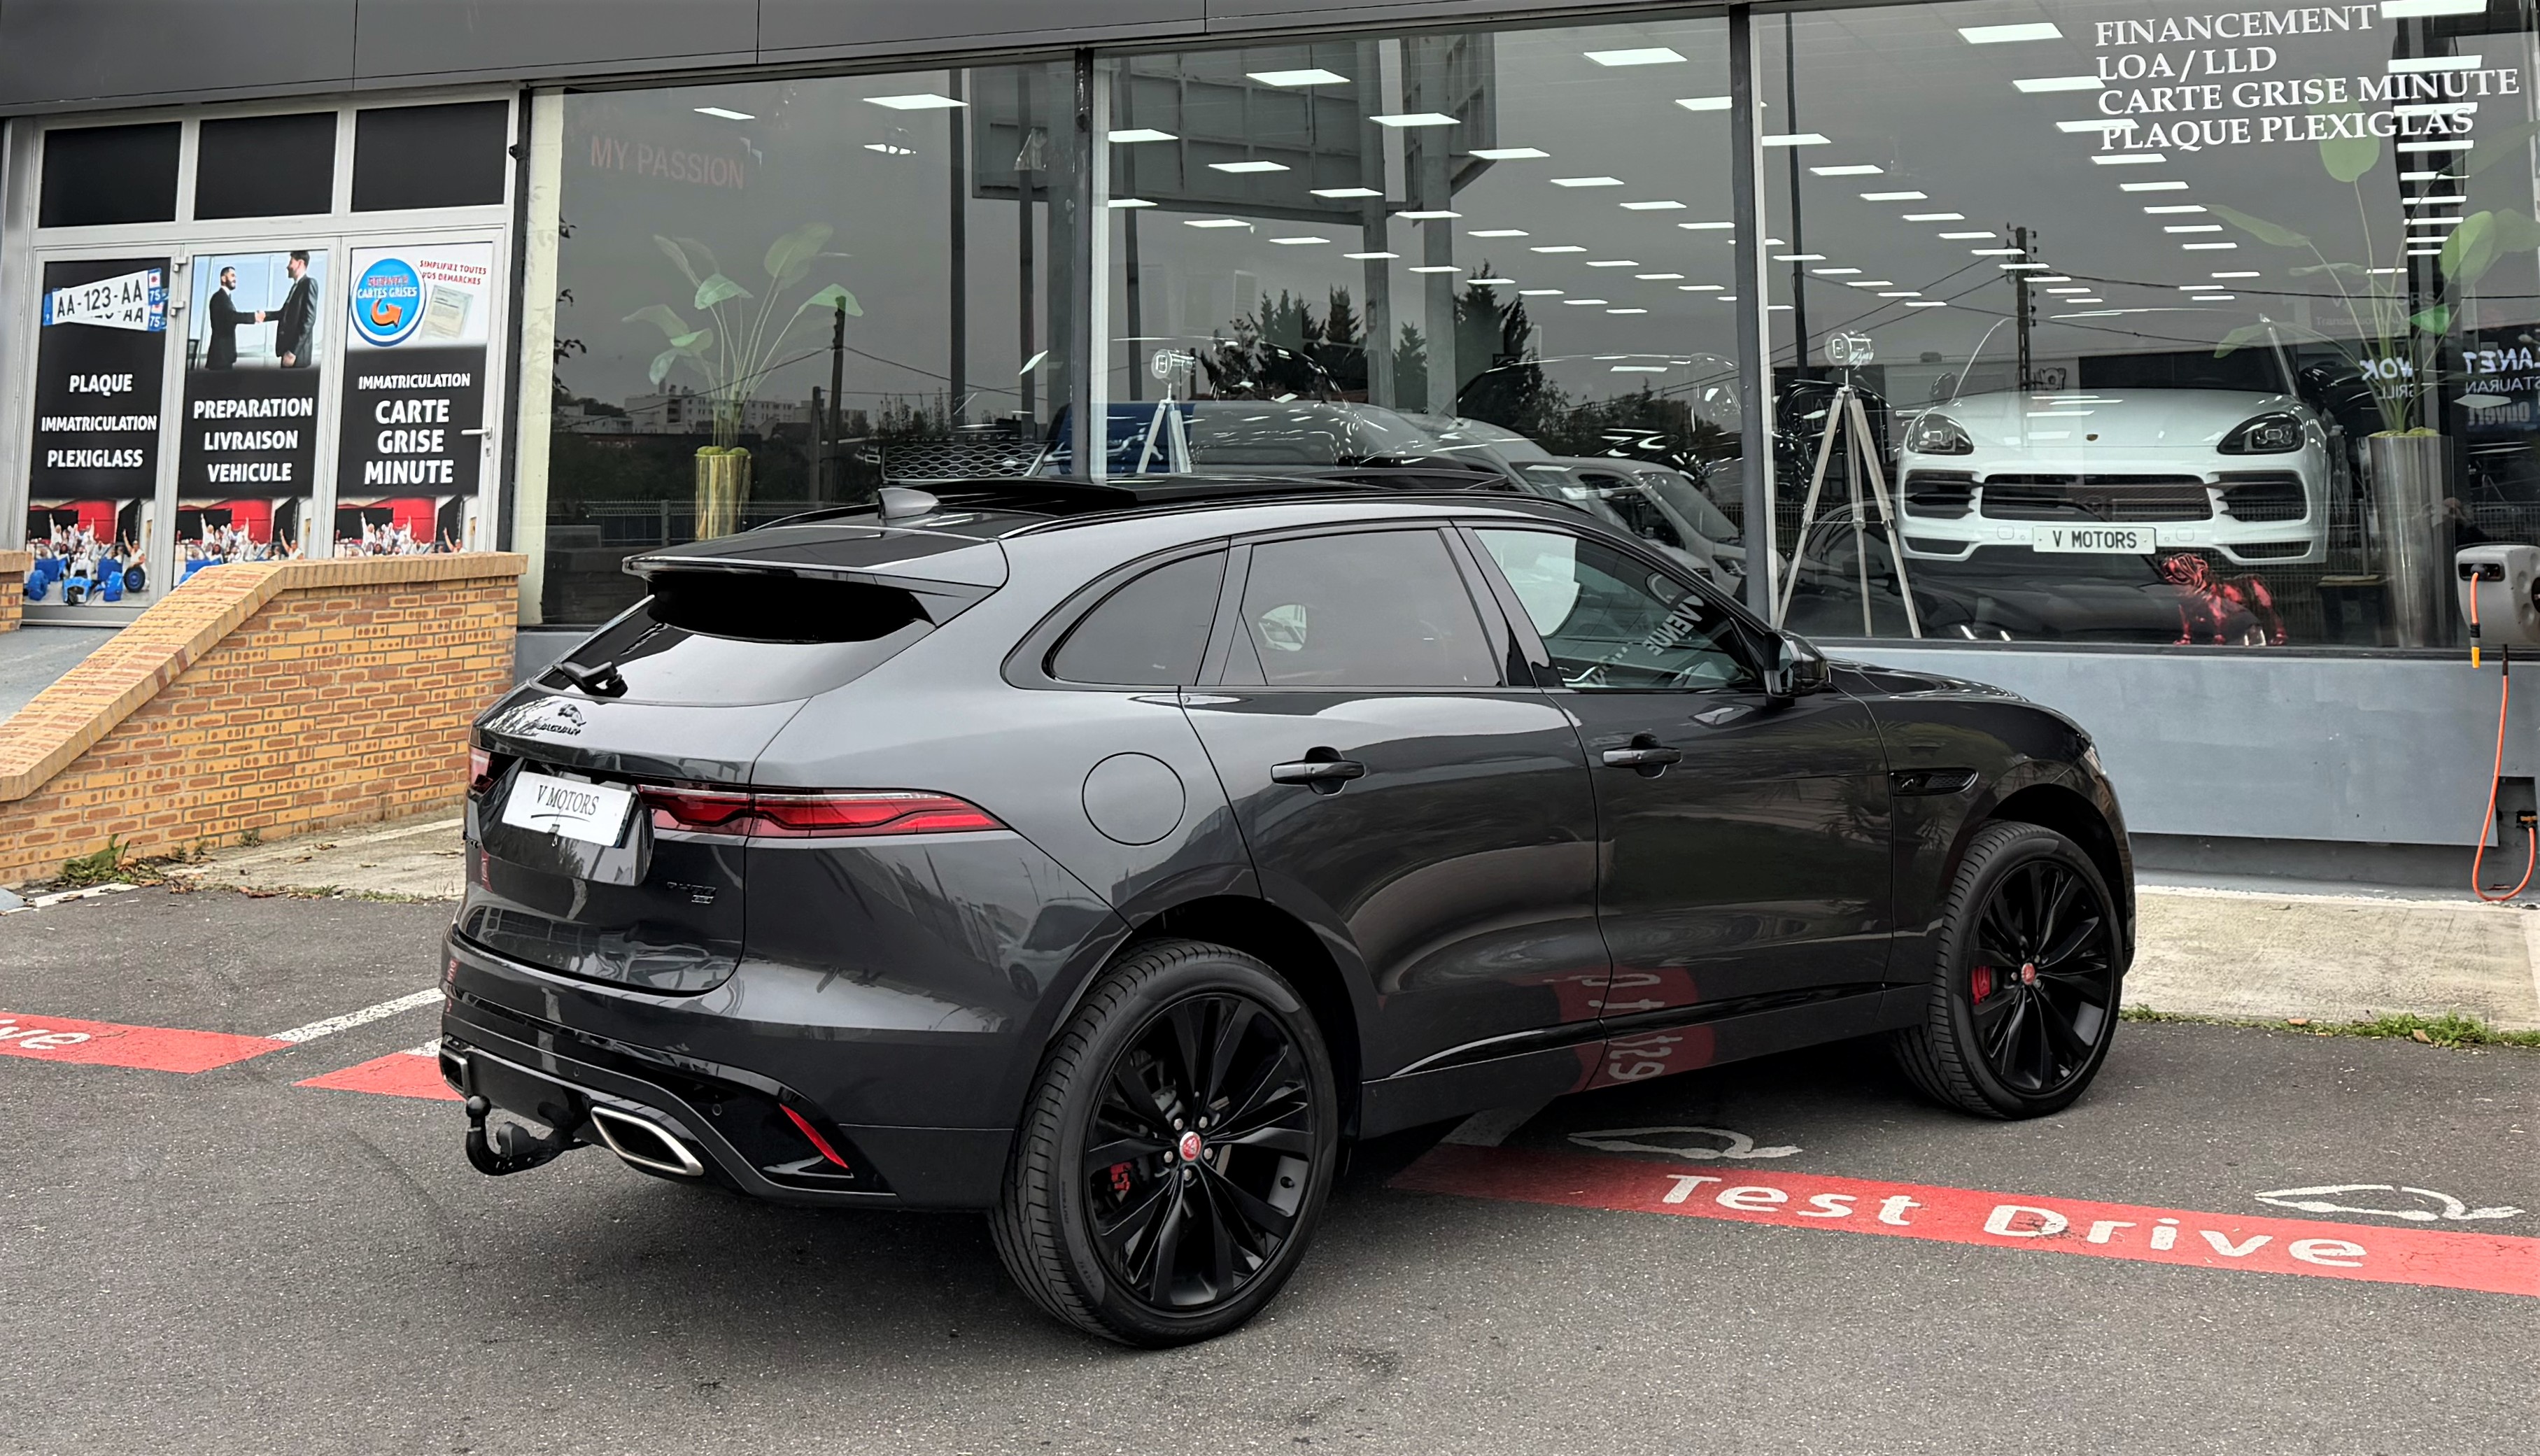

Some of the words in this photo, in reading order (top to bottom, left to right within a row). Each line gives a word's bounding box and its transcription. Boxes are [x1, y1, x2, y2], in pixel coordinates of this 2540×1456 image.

[2094, 4, 2377, 47] FINANCEMENT
[2098, 85, 2222, 115] CARTE
[2232, 77, 2348, 108] GRISE
[2357, 69, 2520, 102] MINUTE
[2101, 118, 2251, 152] PLAQUE
[2260, 108, 2474, 143] PLEXIGLAS
[591, 136, 629, 170] MY
[637, 142, 745, 190] PASSION
[357, 287, 387, 299] CARTES
[388, 286, 418, 297] GRISES
[69, 374, 133, 397] PLAQUE
[358, 373, 471, 390] IMMATRICULATION
[193, 397, 313, 419] PREPARATION
[375, 399, 450, 424] CARTE
[41, 415, 157, 432] IMMATRICULATION
[204, 430, 299, 451] LIVRAISON
[377, 429, 444, 454] GRISE
[47, 449, 143, 467] PLEXIGLASS
[207, 462, 292, 483] VEHICULE
[364, 459, 454, 485] MINUTE
[2052, 530, 2062, 548] V
[2071, 530, 2137, 549] MOTORS
[537, 784, 548, 804] V
[546, 786, 600, 816] MOTORS
[1662, 1173, 1921, 1226] Test
[1982, 1203, 2367, 1268] Drive
